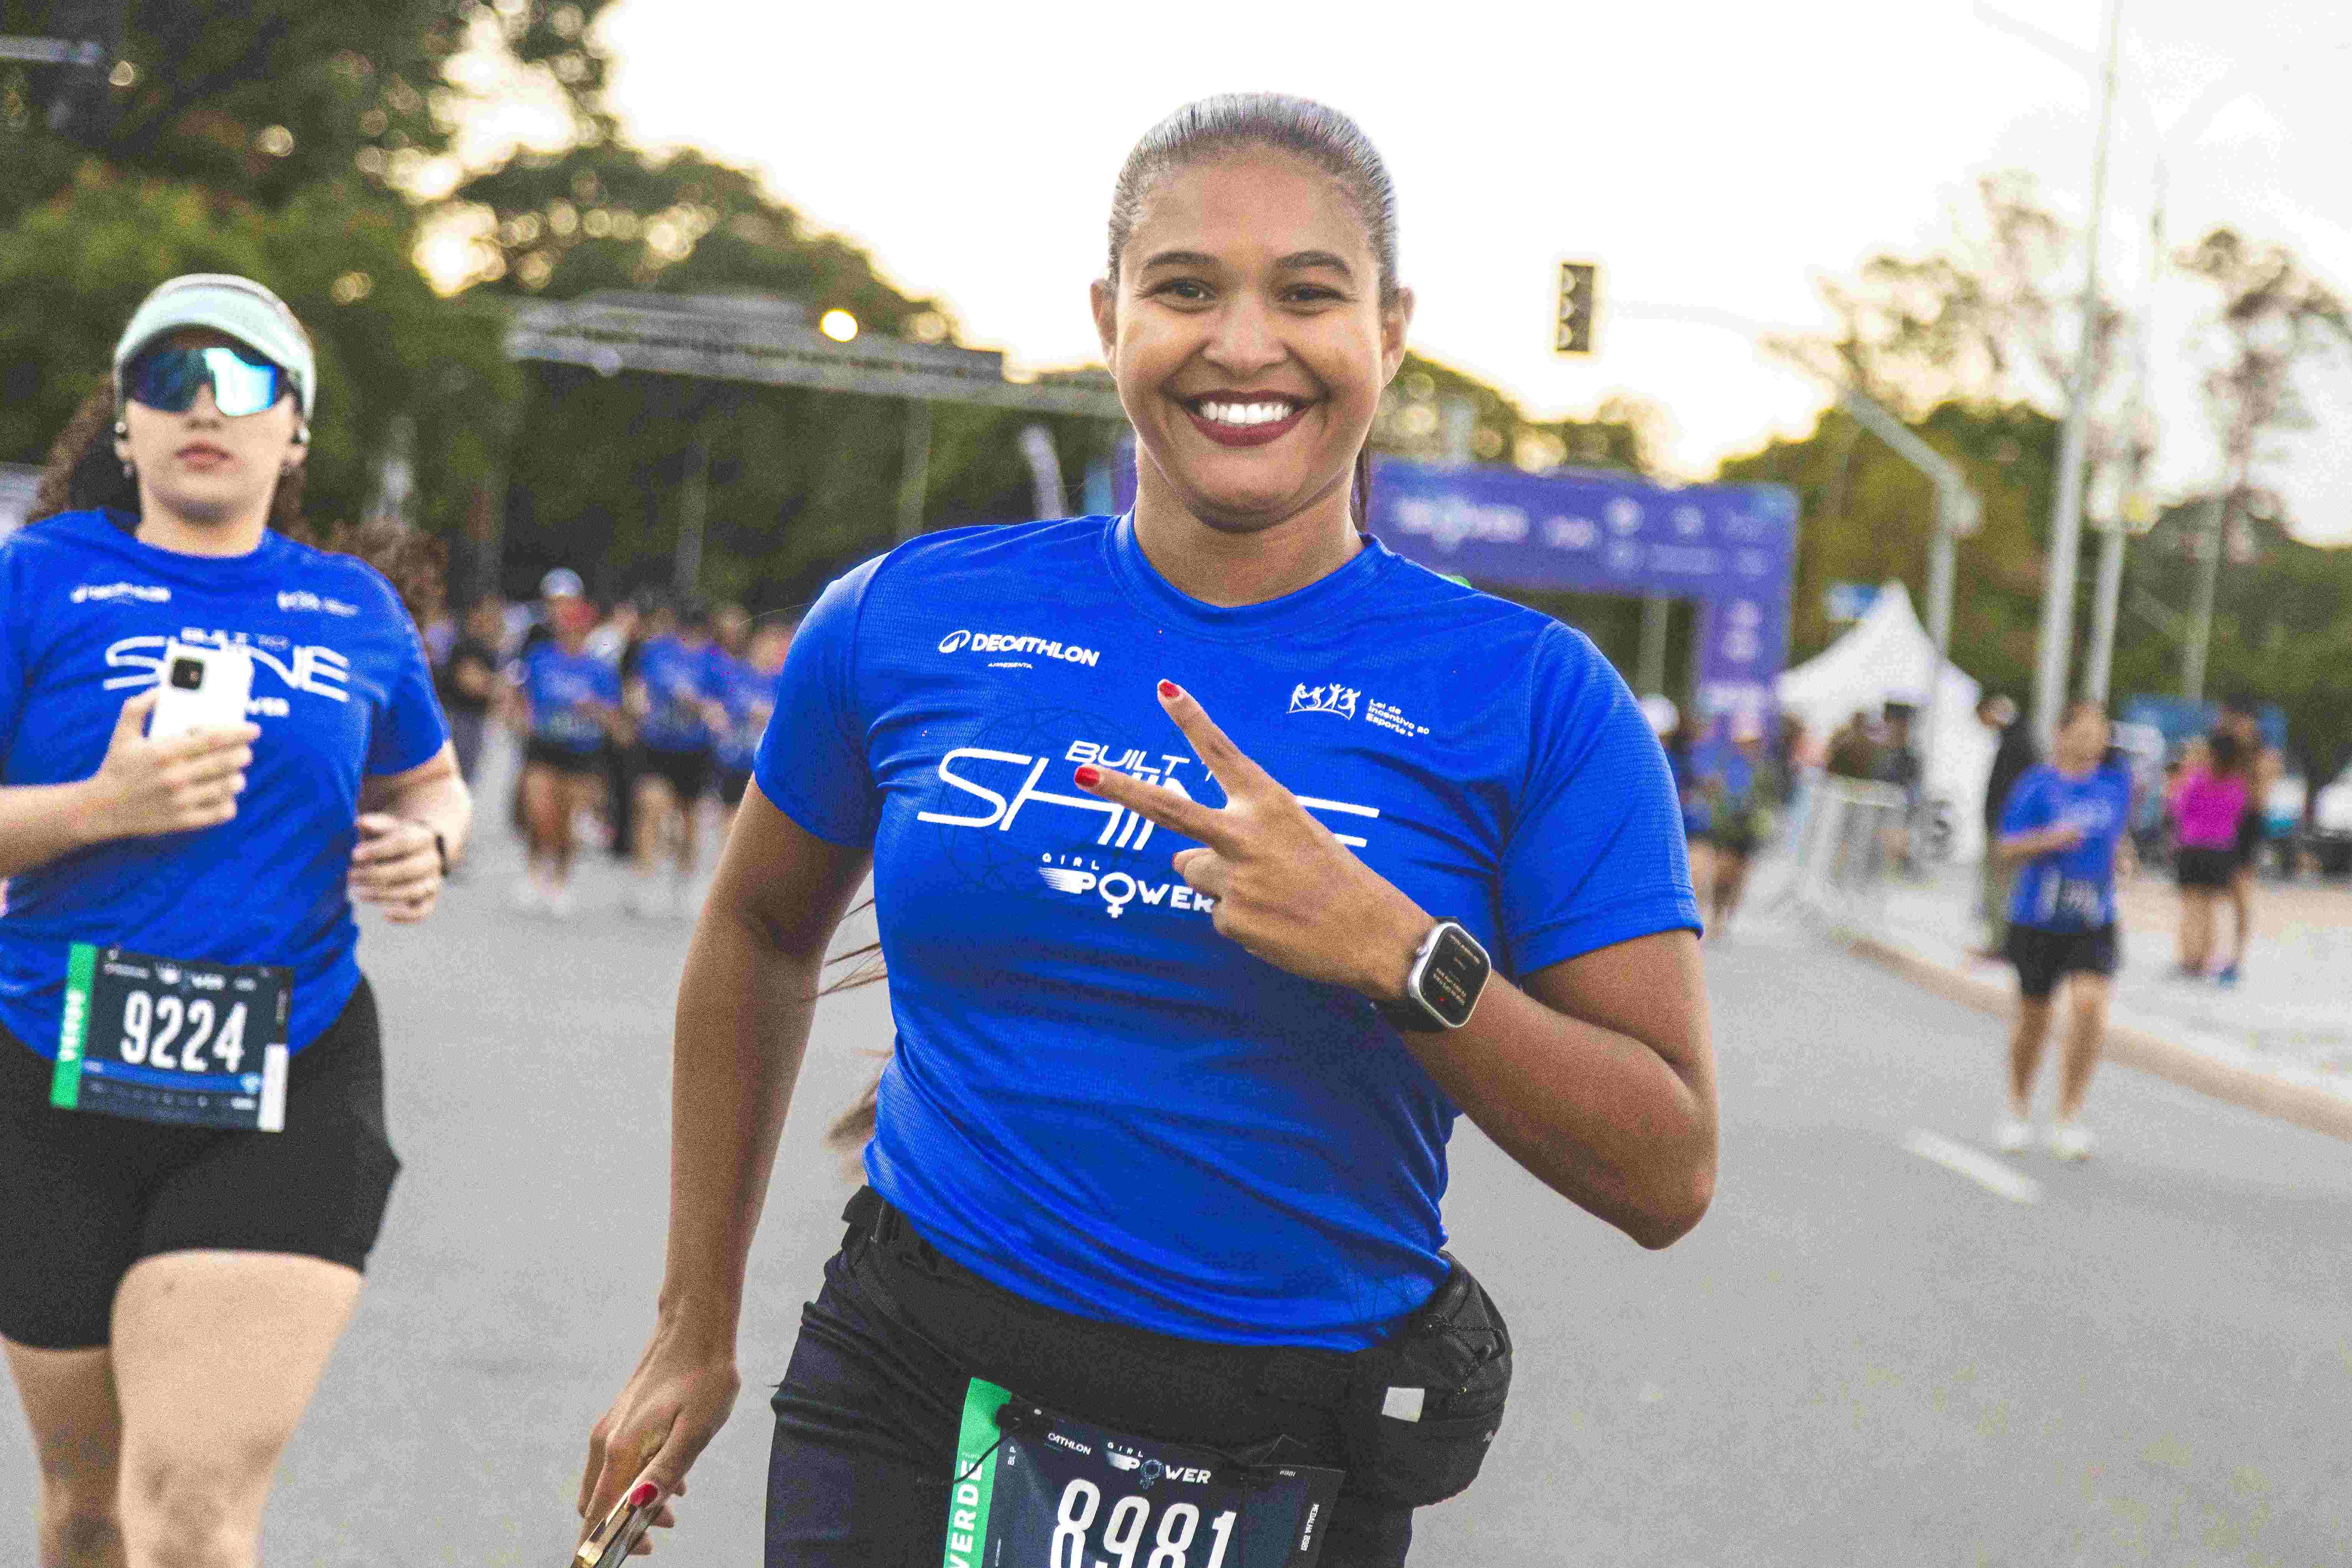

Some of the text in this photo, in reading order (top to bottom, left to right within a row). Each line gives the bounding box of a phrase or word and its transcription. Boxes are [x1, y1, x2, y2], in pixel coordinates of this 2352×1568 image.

[971, 633, 1100, 667] DECATHLON
[103, 634, 350, 702] SNE
[1370, 698, 1402, 715] Lei de
[1366, 713, 1406, 735] Esporte
[1065, 740, 1190, 776] BUILT
[1042, 853, 1100, 870] GIRL
[120, 990, 248, 1073] 9224
[1048, 1431, 1092, 1455] CATHLON
[1107, 1441, 1144, 1458] GIRL
[1050, 1478, 1237, 1568] 8981
